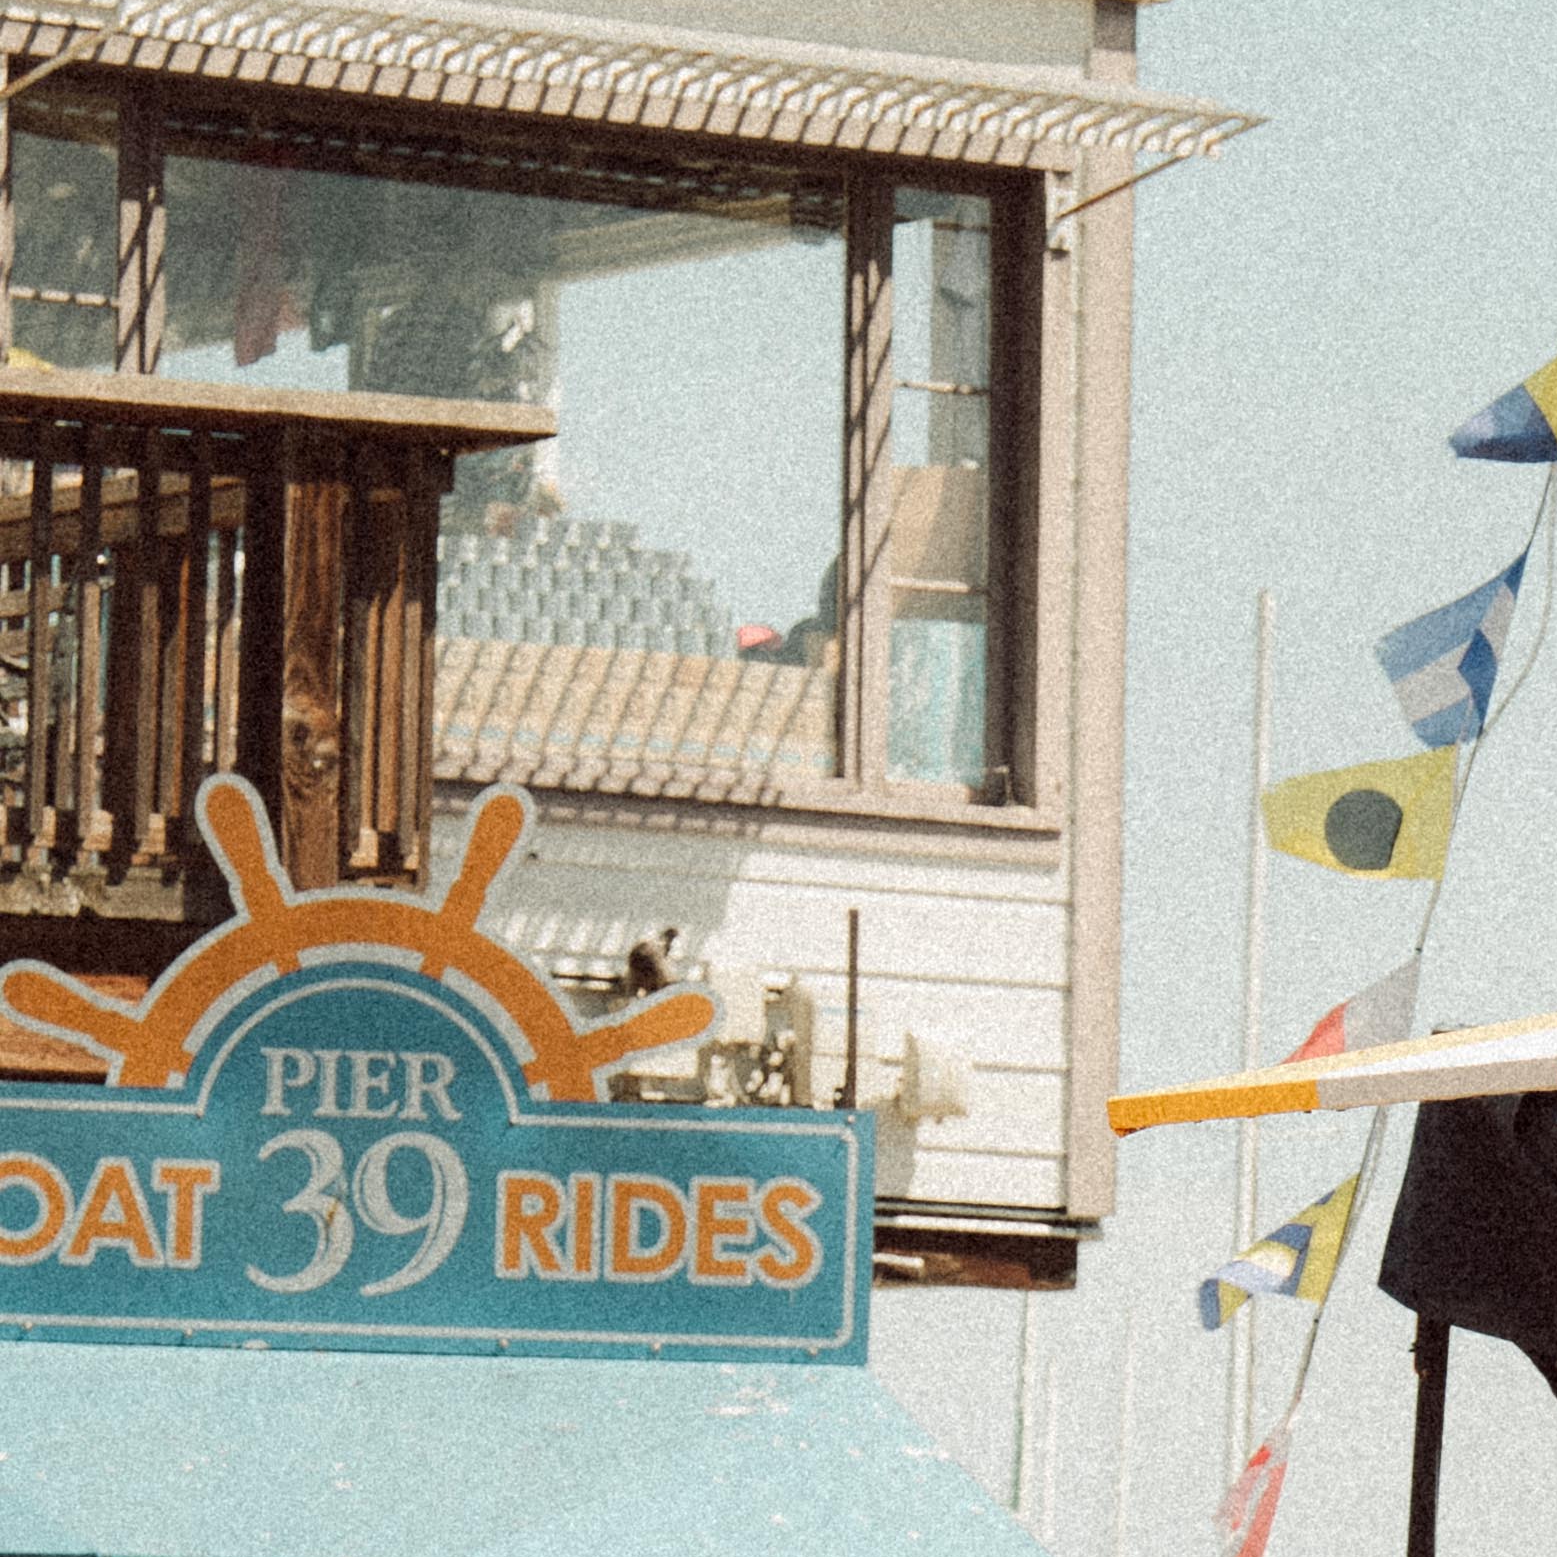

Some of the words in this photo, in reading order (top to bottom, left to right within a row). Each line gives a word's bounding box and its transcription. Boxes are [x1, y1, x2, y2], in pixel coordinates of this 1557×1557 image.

[259, 1046, 462, 1124] PIER
[0, 1152, 221, 1270] OAT
[493, 1170, 823, 1289] RIDES
[244, 1127, 470, 1298] 39
